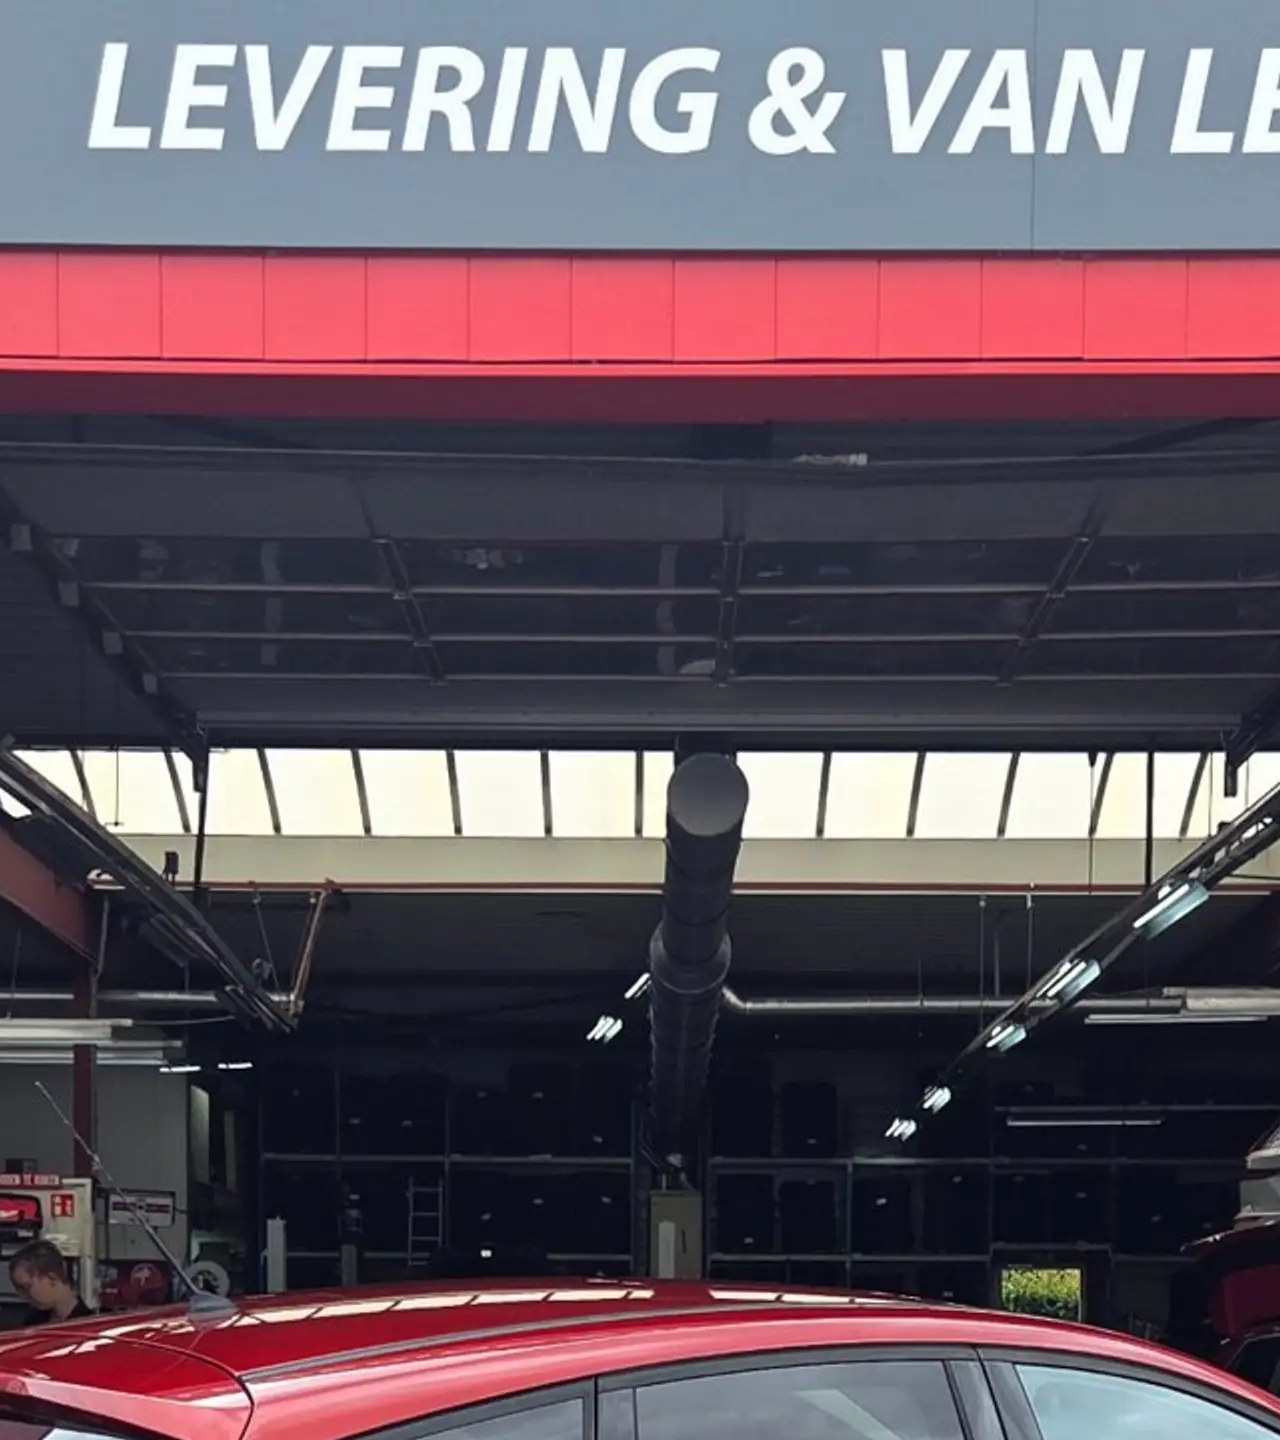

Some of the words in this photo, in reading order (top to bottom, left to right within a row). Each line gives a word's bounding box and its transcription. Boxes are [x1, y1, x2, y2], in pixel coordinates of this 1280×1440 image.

[86, 41, 721, 154] LEVERING
[747, 45, 847, 155] &
[880, 47, 1146, 155] VAN
